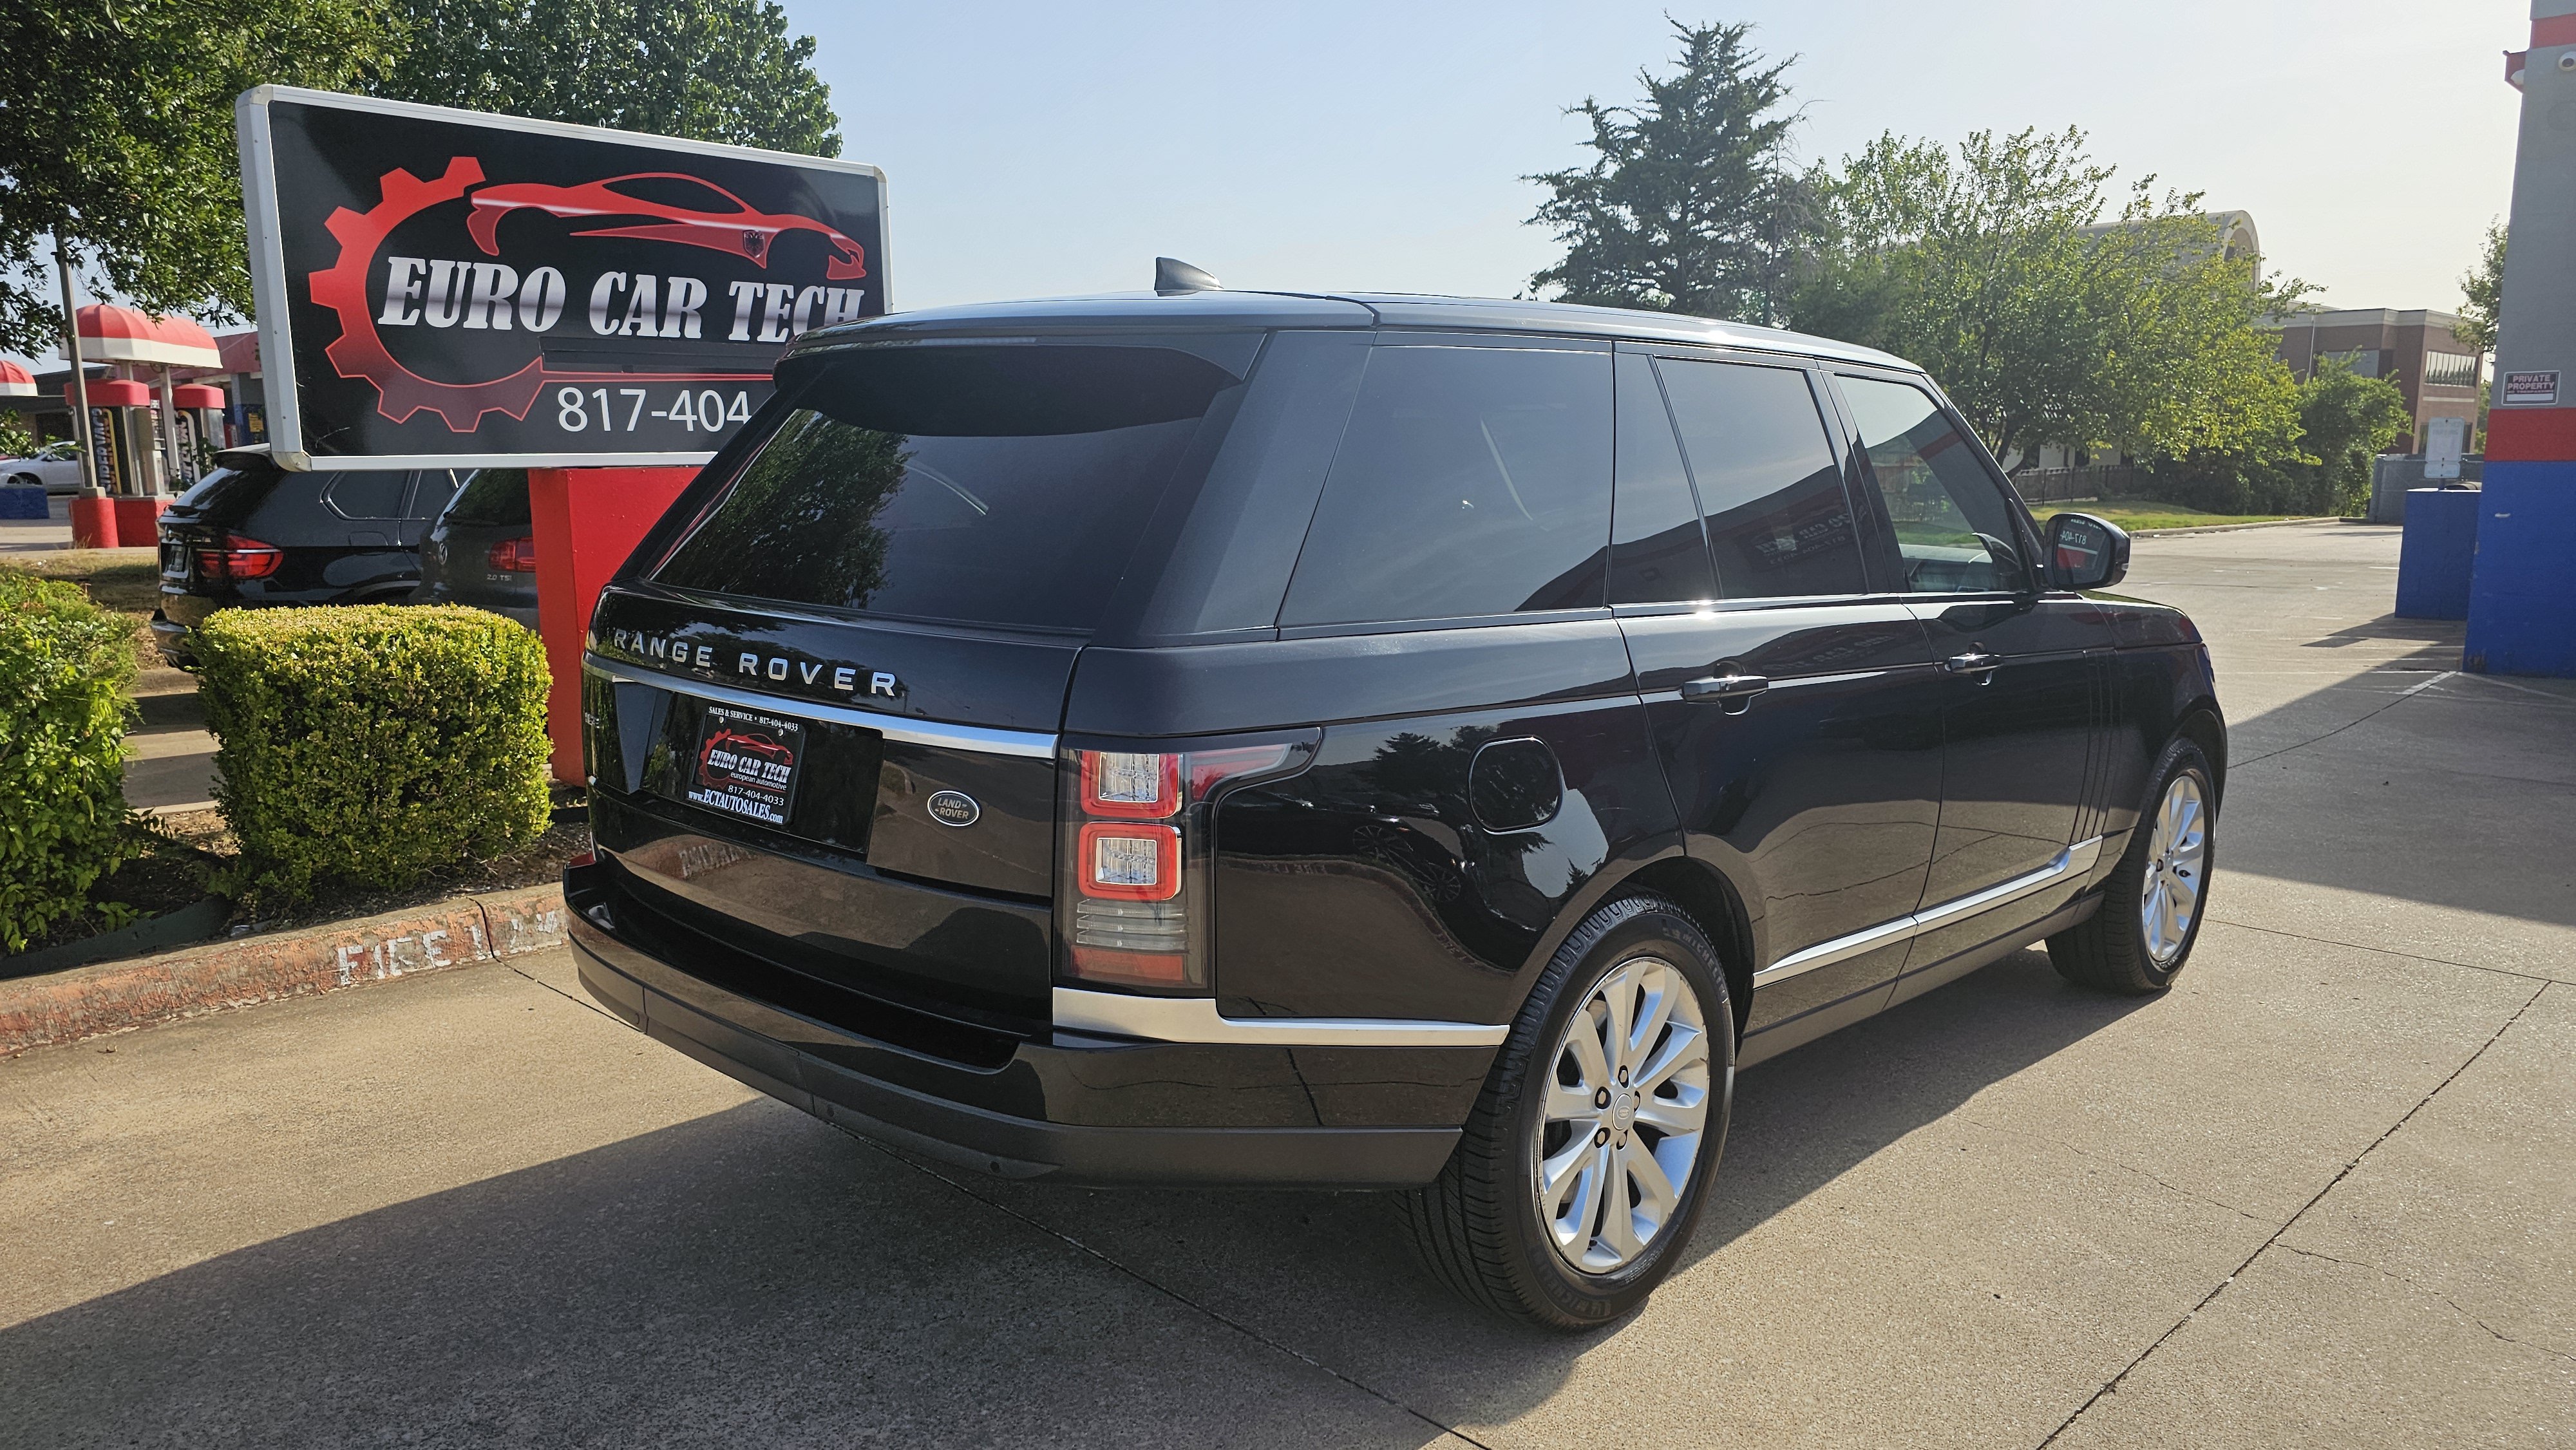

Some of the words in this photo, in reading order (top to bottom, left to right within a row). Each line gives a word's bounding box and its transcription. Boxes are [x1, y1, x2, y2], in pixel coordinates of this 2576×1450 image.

[377, 256, 566, 332] EURO
[589, 271, 707, 339] CAR
[728, 281, 865, 343] TECH
[2507, 382, 2555, 390] PROPERTY
[558, 387, 752, 432] 817-404
[614, 629, 713, 667] RANGE
[739, 652, 896, 696] ROVER
[708, 706, 724, 716] SALES
[730, 711, 753, 721] SERVICE
[759, 716, 799, 731] 817-404-4033
[707, 749, 738, 770] EURO
[739, 757, 761, 777] CAR
[761, 762, 791, 783] TECH
[728, 785, 784, 806] 817-404-4033
[730, 772, 755, 783] european
[755, 777, 787, 791] automotive
[688, 789, 783, 824] www.ECTAUTOSALES.com
[938, 797, 961, 809] LAND
[939, 807, 969, 820] ROVER
[338, 930, 451, 986] FIRE
